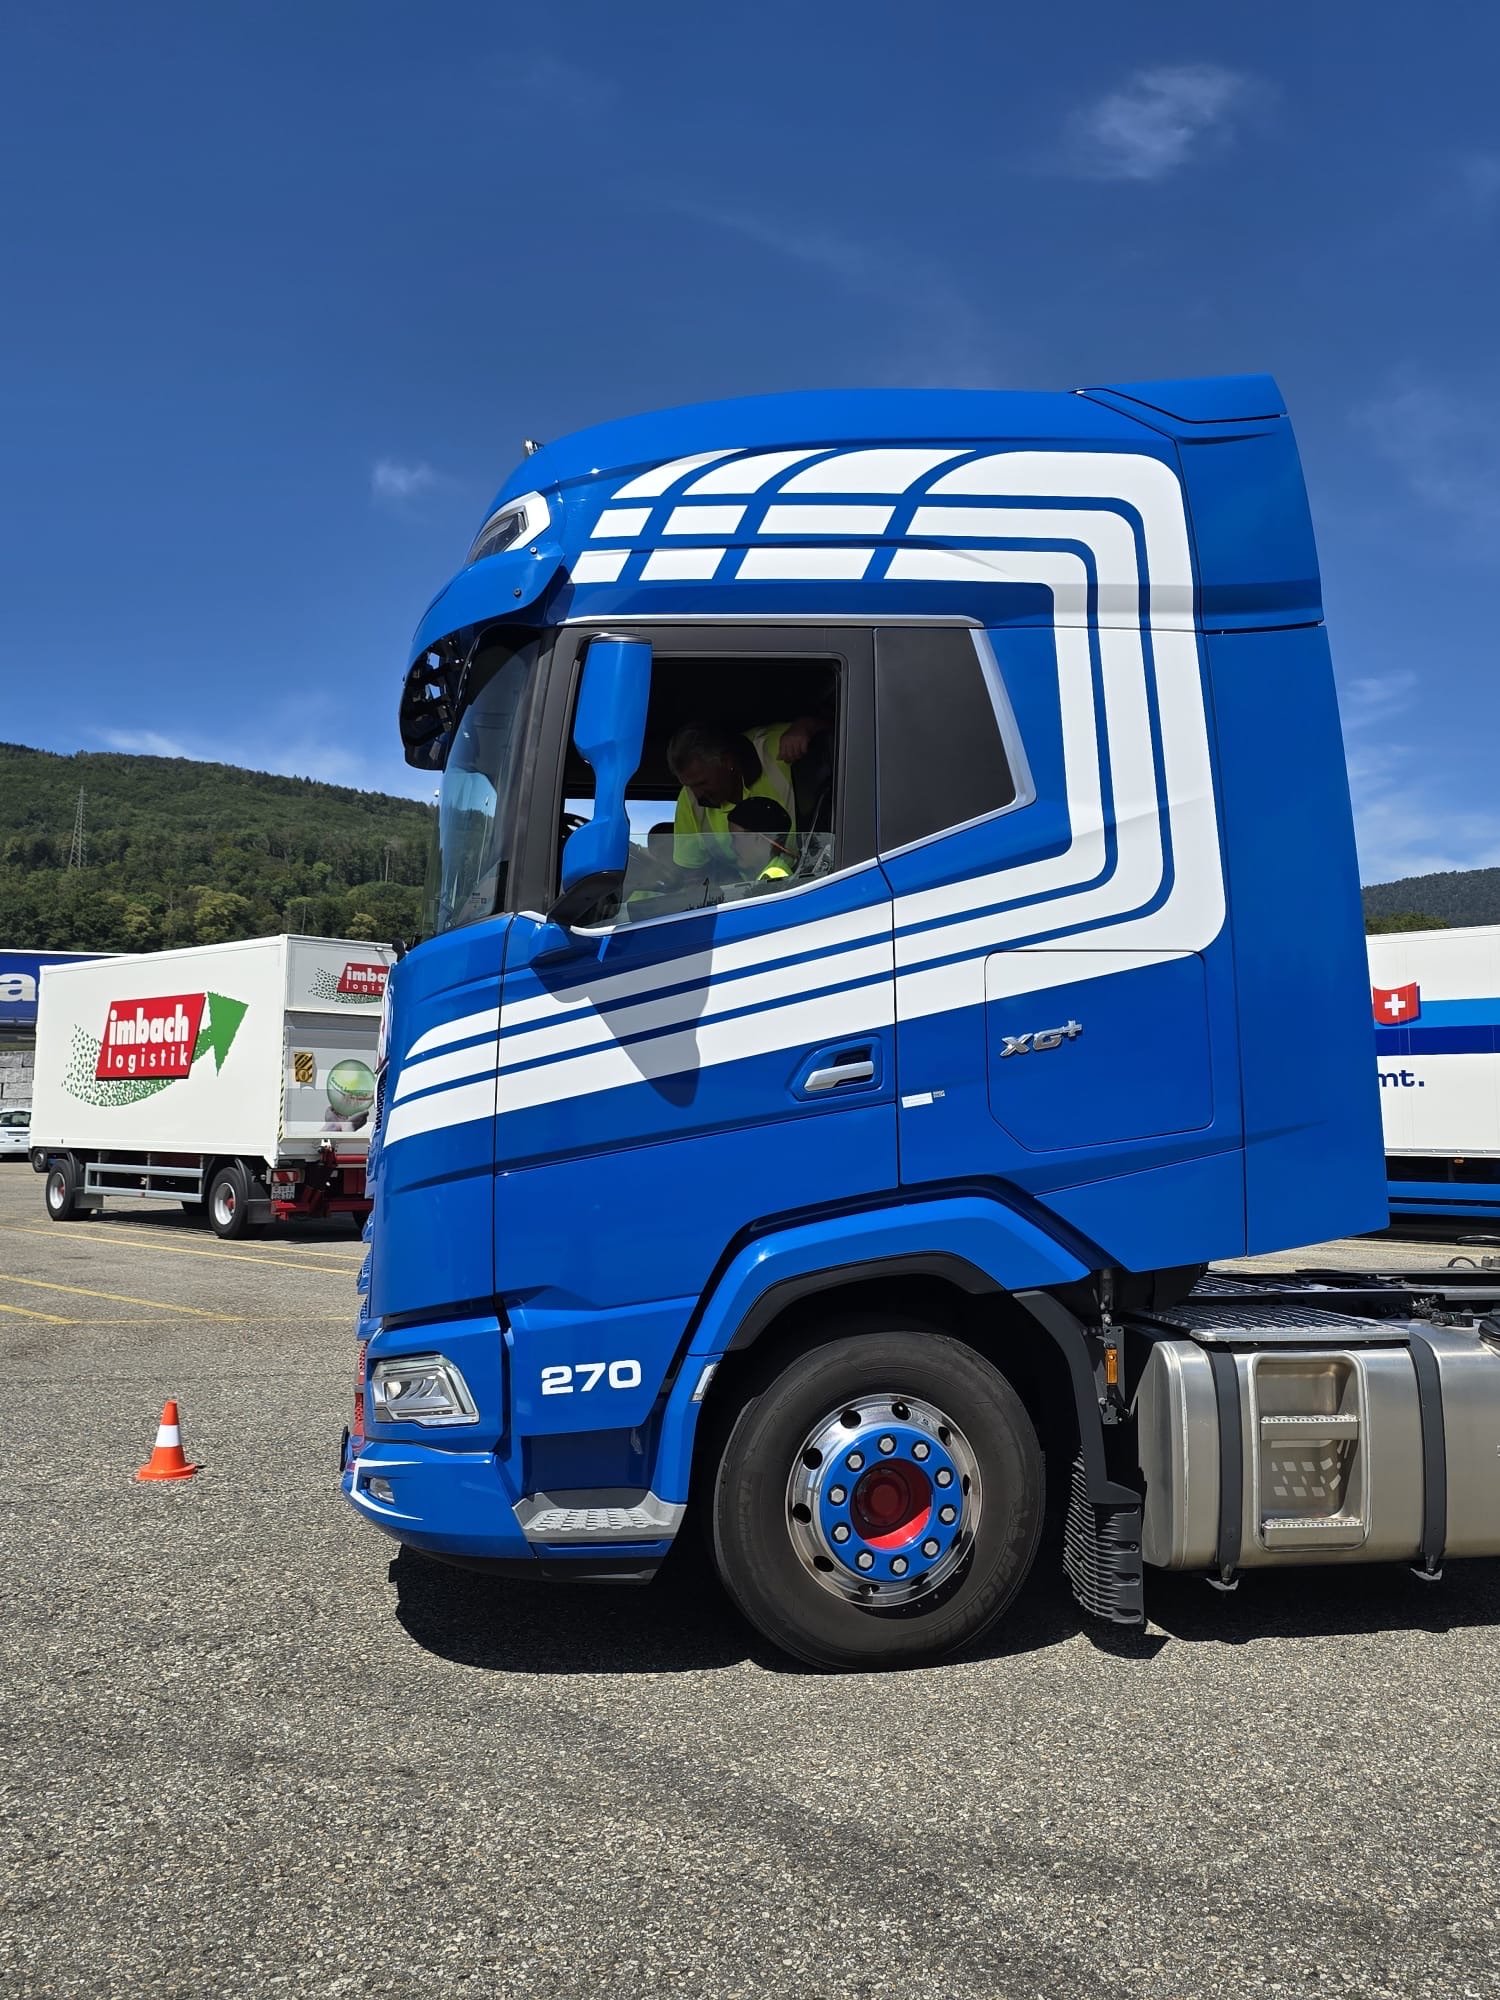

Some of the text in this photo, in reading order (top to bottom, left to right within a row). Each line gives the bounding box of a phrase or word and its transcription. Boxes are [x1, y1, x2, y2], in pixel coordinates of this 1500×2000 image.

[109, 1003, 189, 1046] imbach
[1000, 1020, 1082, 1056] XG+
[107, 1043, 188, 1074] logistik
[541, 1359, 642, 1396] 270
